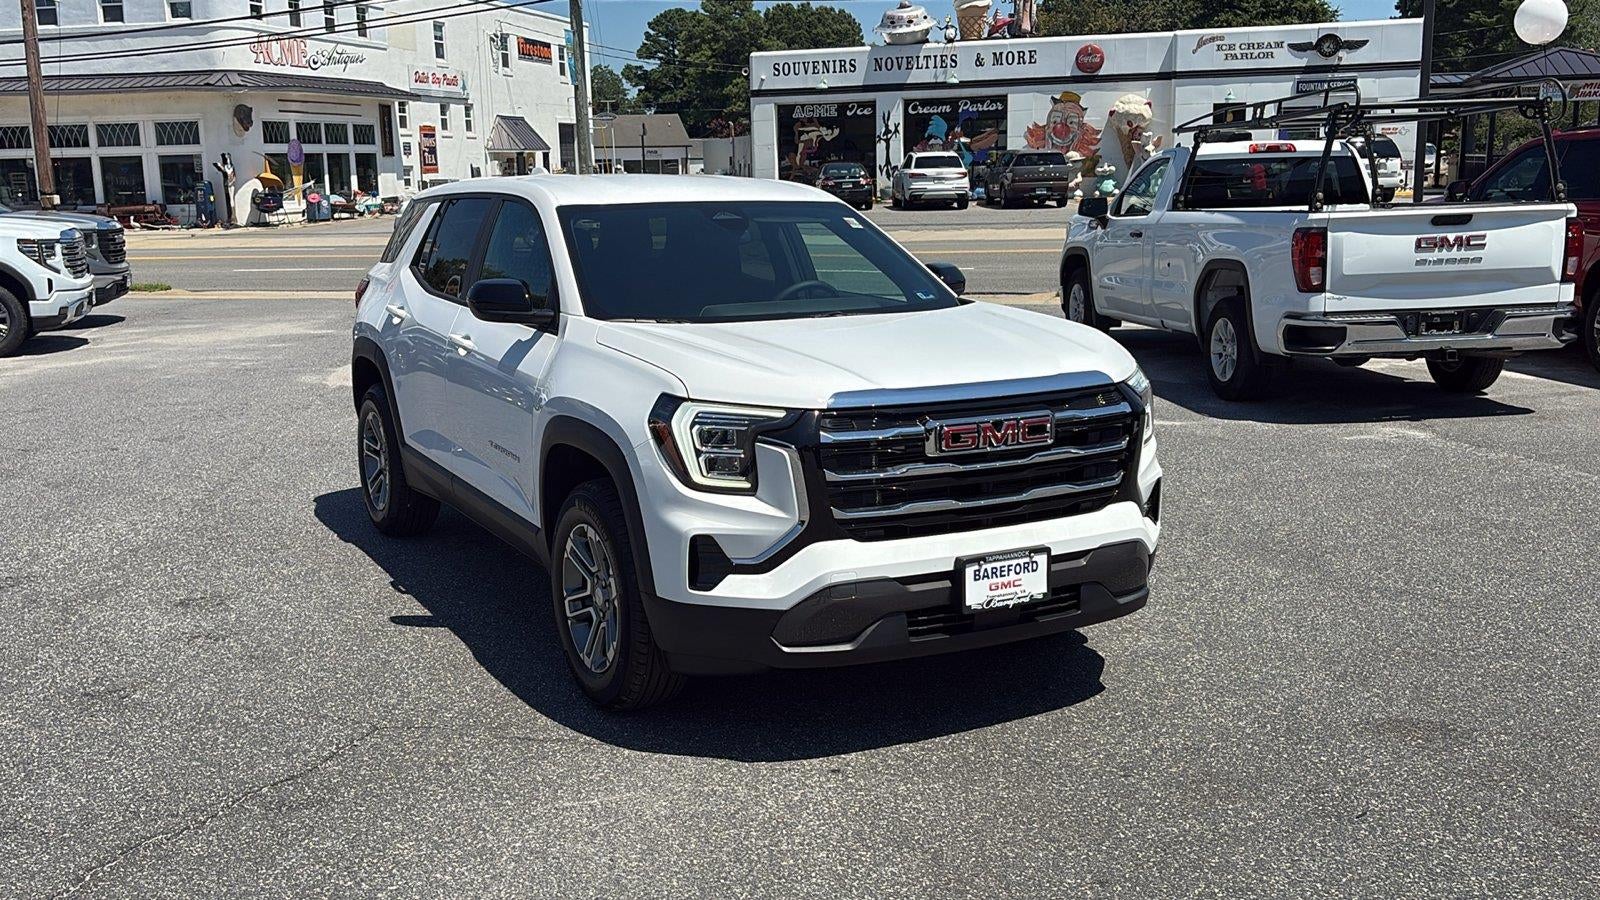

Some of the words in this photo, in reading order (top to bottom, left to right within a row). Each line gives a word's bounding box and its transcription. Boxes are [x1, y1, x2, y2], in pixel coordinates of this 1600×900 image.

[250, 34, 308, 68] ACME
[517, 36, 552, 58] Firestone
[1216, 43, 1236, 52] ICE
[1239, 41, 1285, 51] CREAM
[773, 59, 857, 77] SOUVENIRS
[874, 54, 958, 72] NOVELTIES
[974, 53, 985, 67] &
[992, 50, 1037, 66] MORE
[1224, 51, 1274, 60] PARLOR
[414, 71, 429, 84] Dutch
[431, 72, 442, 88] Boy
[442, 73, 459, 87] Paints
[1298, 82, 1328, 92] FOUNTAIN
[792, 104, 837, 118] ACME
[846, 102, 873, 116] Ice
[908, 101, 952, 114] Cream
[958, 100, 1005, 113] Parlor
[424, 152, 436, 164] TEA
[1414, 233, 1487, 253] GMC
[942, 416, 1051, 452] GMC
[985, 550, 1030, 562] TAPPAHANNOCK
[973, 560, 1039, 581] BAREFORD
[988, 578, 1023, 592] GMC
